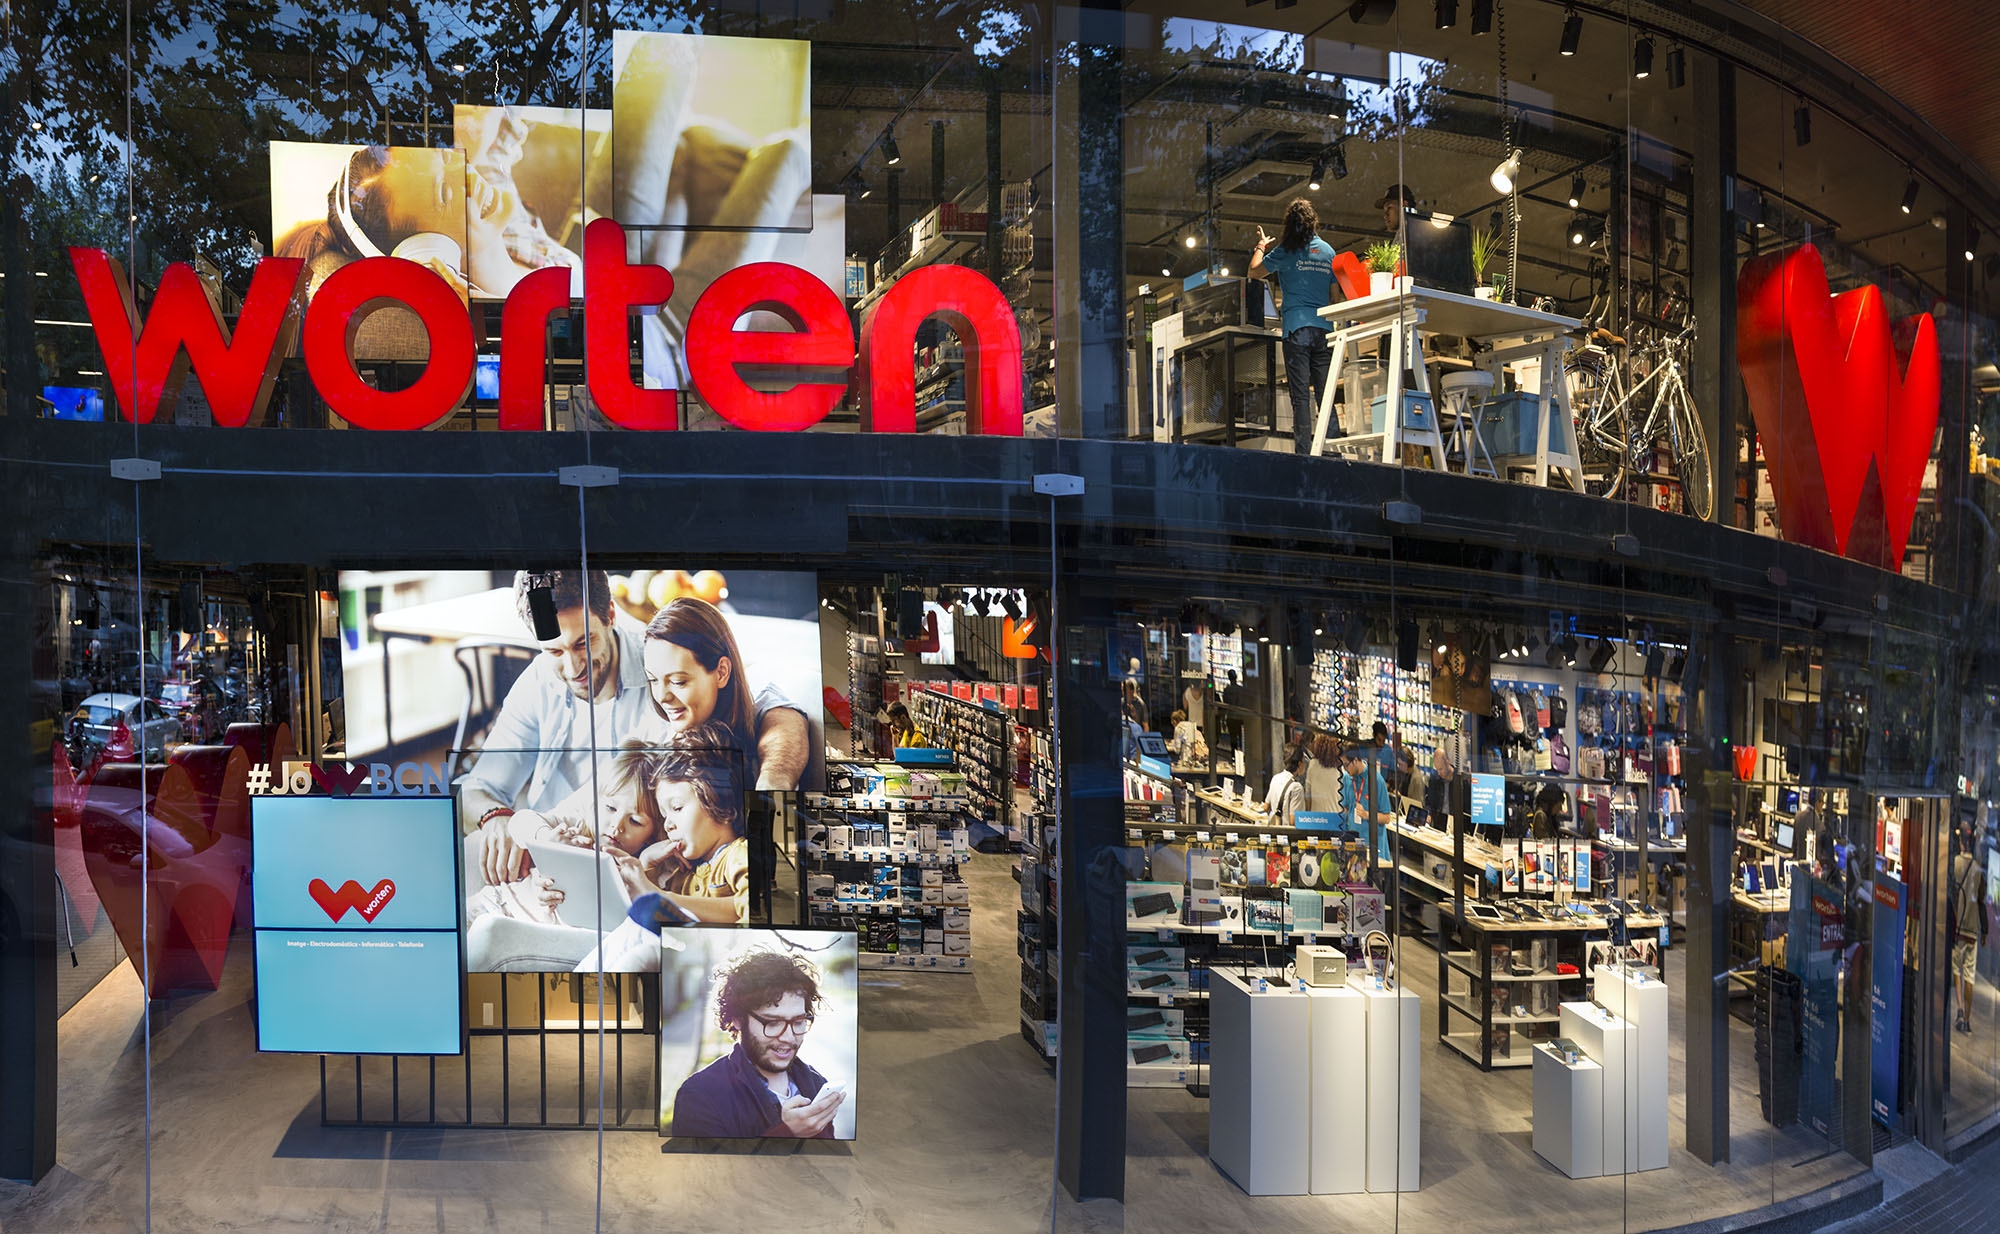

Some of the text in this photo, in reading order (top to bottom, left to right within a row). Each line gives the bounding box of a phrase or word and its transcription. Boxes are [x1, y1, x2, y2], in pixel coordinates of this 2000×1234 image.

[68, 217, 1025, 437] worten
[363, 884, 393, 915] worten
[1875, 887, 1897, 905] worten
